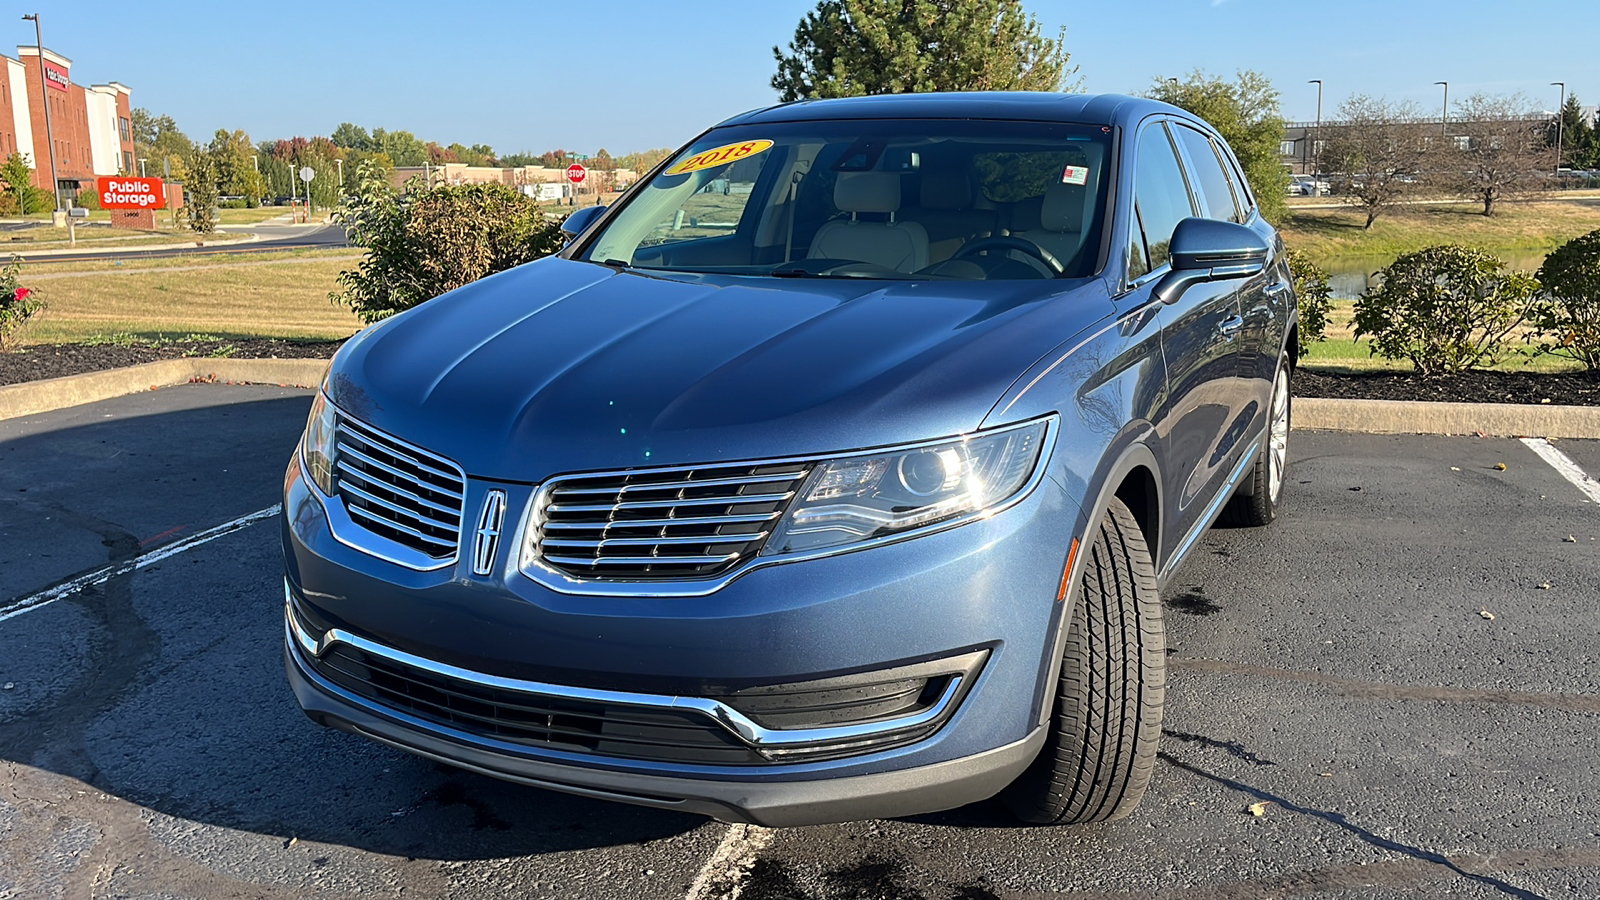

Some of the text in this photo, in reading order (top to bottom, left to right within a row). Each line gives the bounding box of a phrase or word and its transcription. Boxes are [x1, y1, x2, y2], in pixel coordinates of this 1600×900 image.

[679, 142, 756, 173] 2018
[568, 169, 585, 178] STOP
[109, 181, 150, 192] Public
[104, 192, 156, 206] Storage
